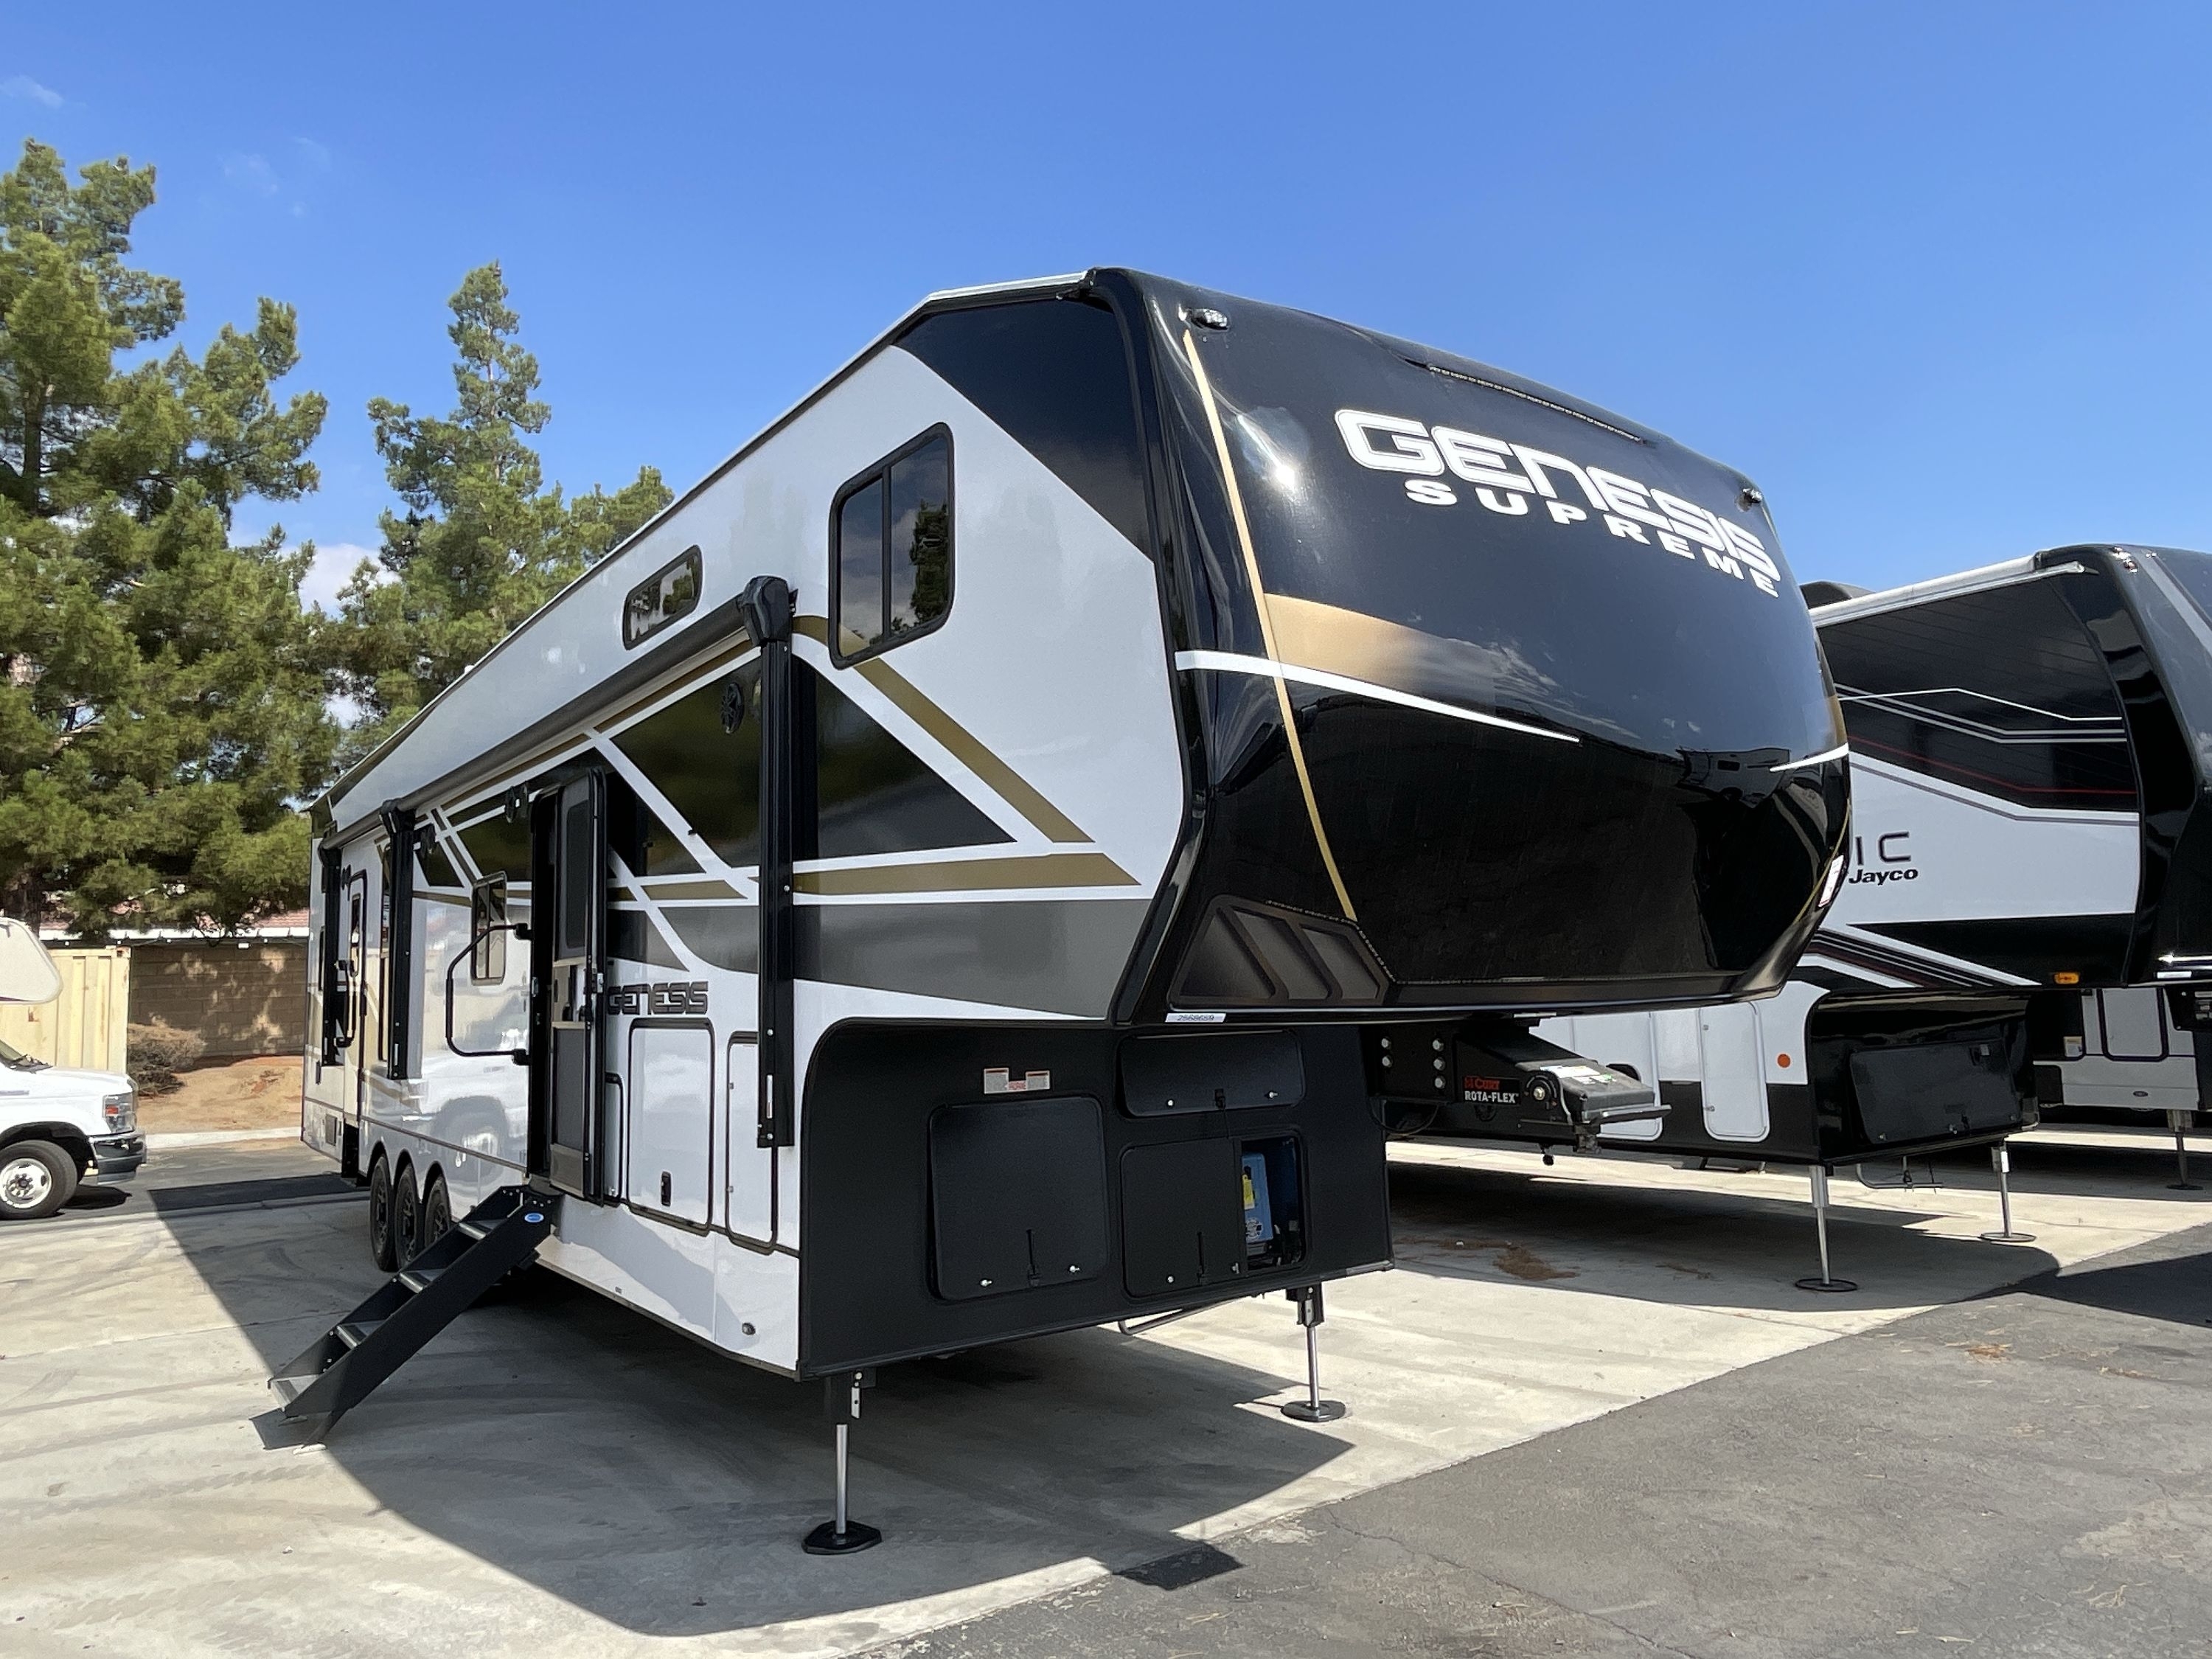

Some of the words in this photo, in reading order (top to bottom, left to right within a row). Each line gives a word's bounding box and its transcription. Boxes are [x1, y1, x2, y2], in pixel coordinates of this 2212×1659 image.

[1335, 408, 1781, 582] GENESIS
[1404, 479, 1778, 597] SUPREME
[1848, 869, 1919, 886] Jayco
[608, 981, 709, 1015] GENESIS
